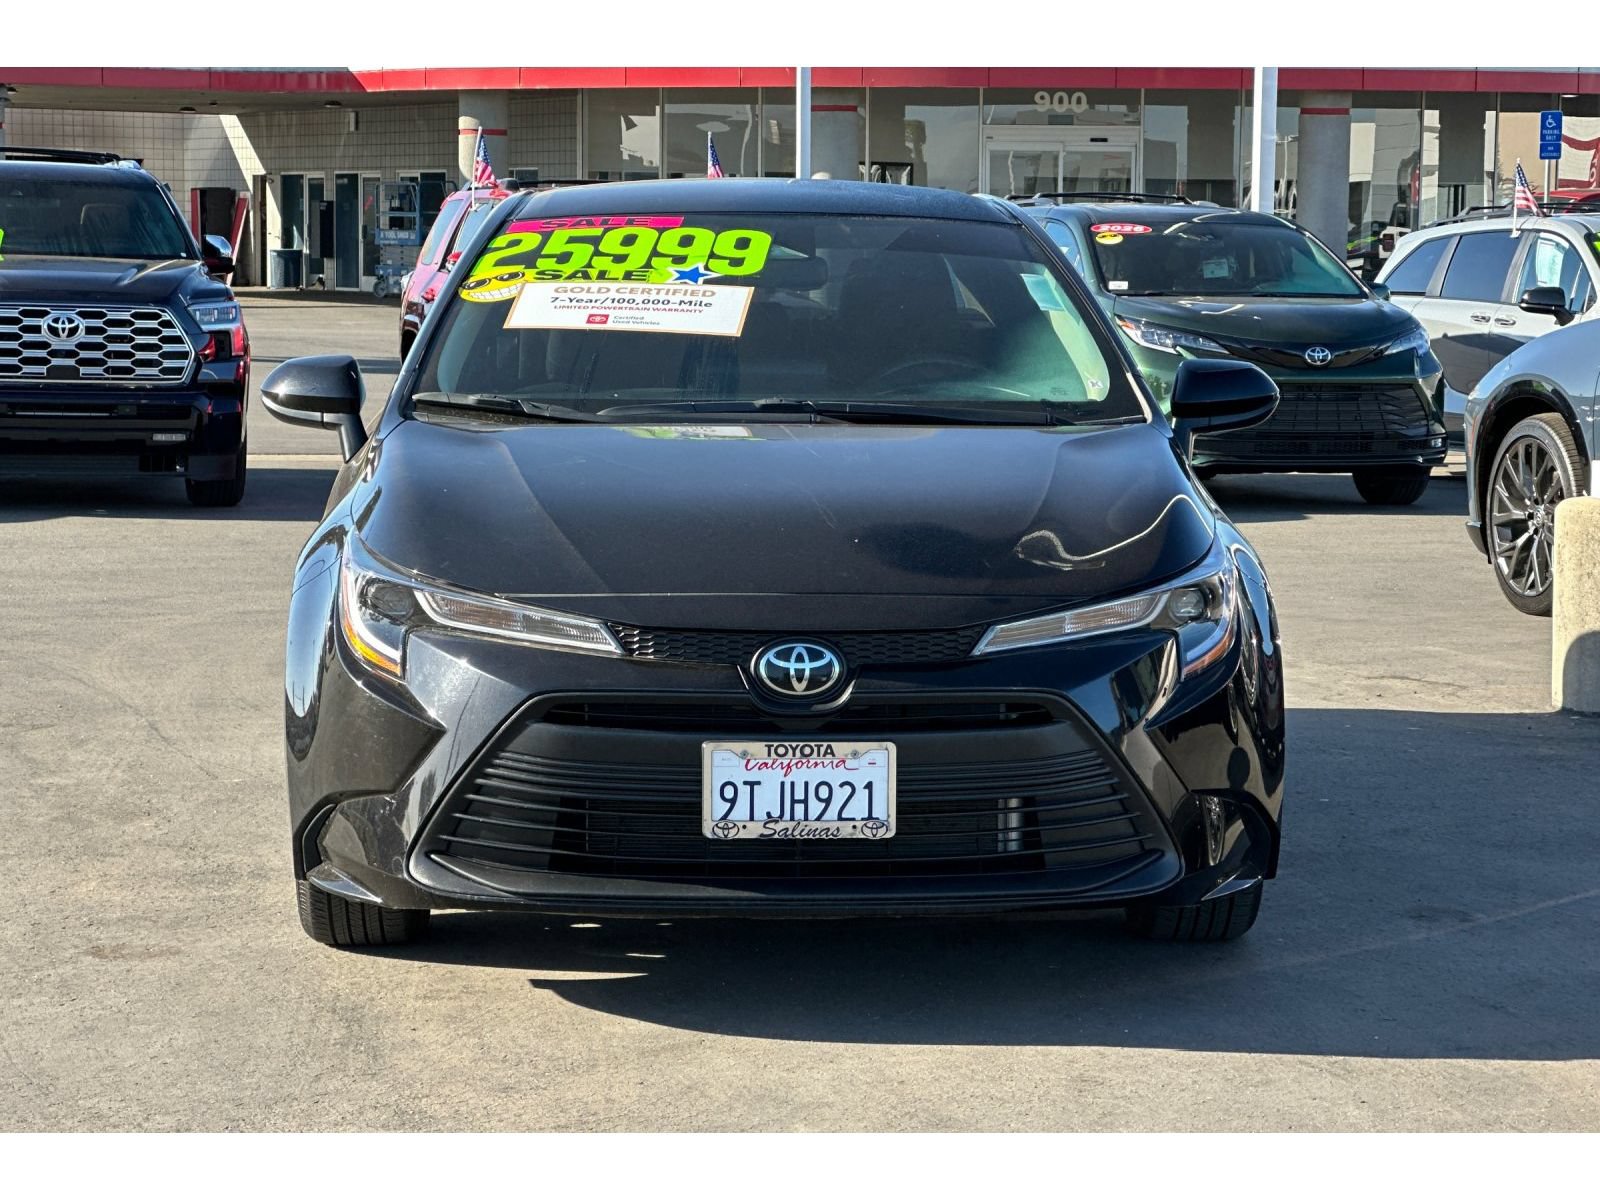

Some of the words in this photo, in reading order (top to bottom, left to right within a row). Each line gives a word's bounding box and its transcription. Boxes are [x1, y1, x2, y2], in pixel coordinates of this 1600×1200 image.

[1034, 90, 1088, 113] 900
[541, 217, 649, 227] SALE
[471, 225, 772, 277] 25999
[534, 269, 649, 280] SALE
[554, 286, 611, 295] GOLD
[615, 287, 716, 298] CERTIFIED
[550, 296, 713, 308] 7-Year/100,000-Mile
[765, 743, 836, 758] TOYOTA
[745, 757, 859, 778] California
[718, 780, 880, 821] 9TJH921
[758, 818, 841, 839] Salinas
